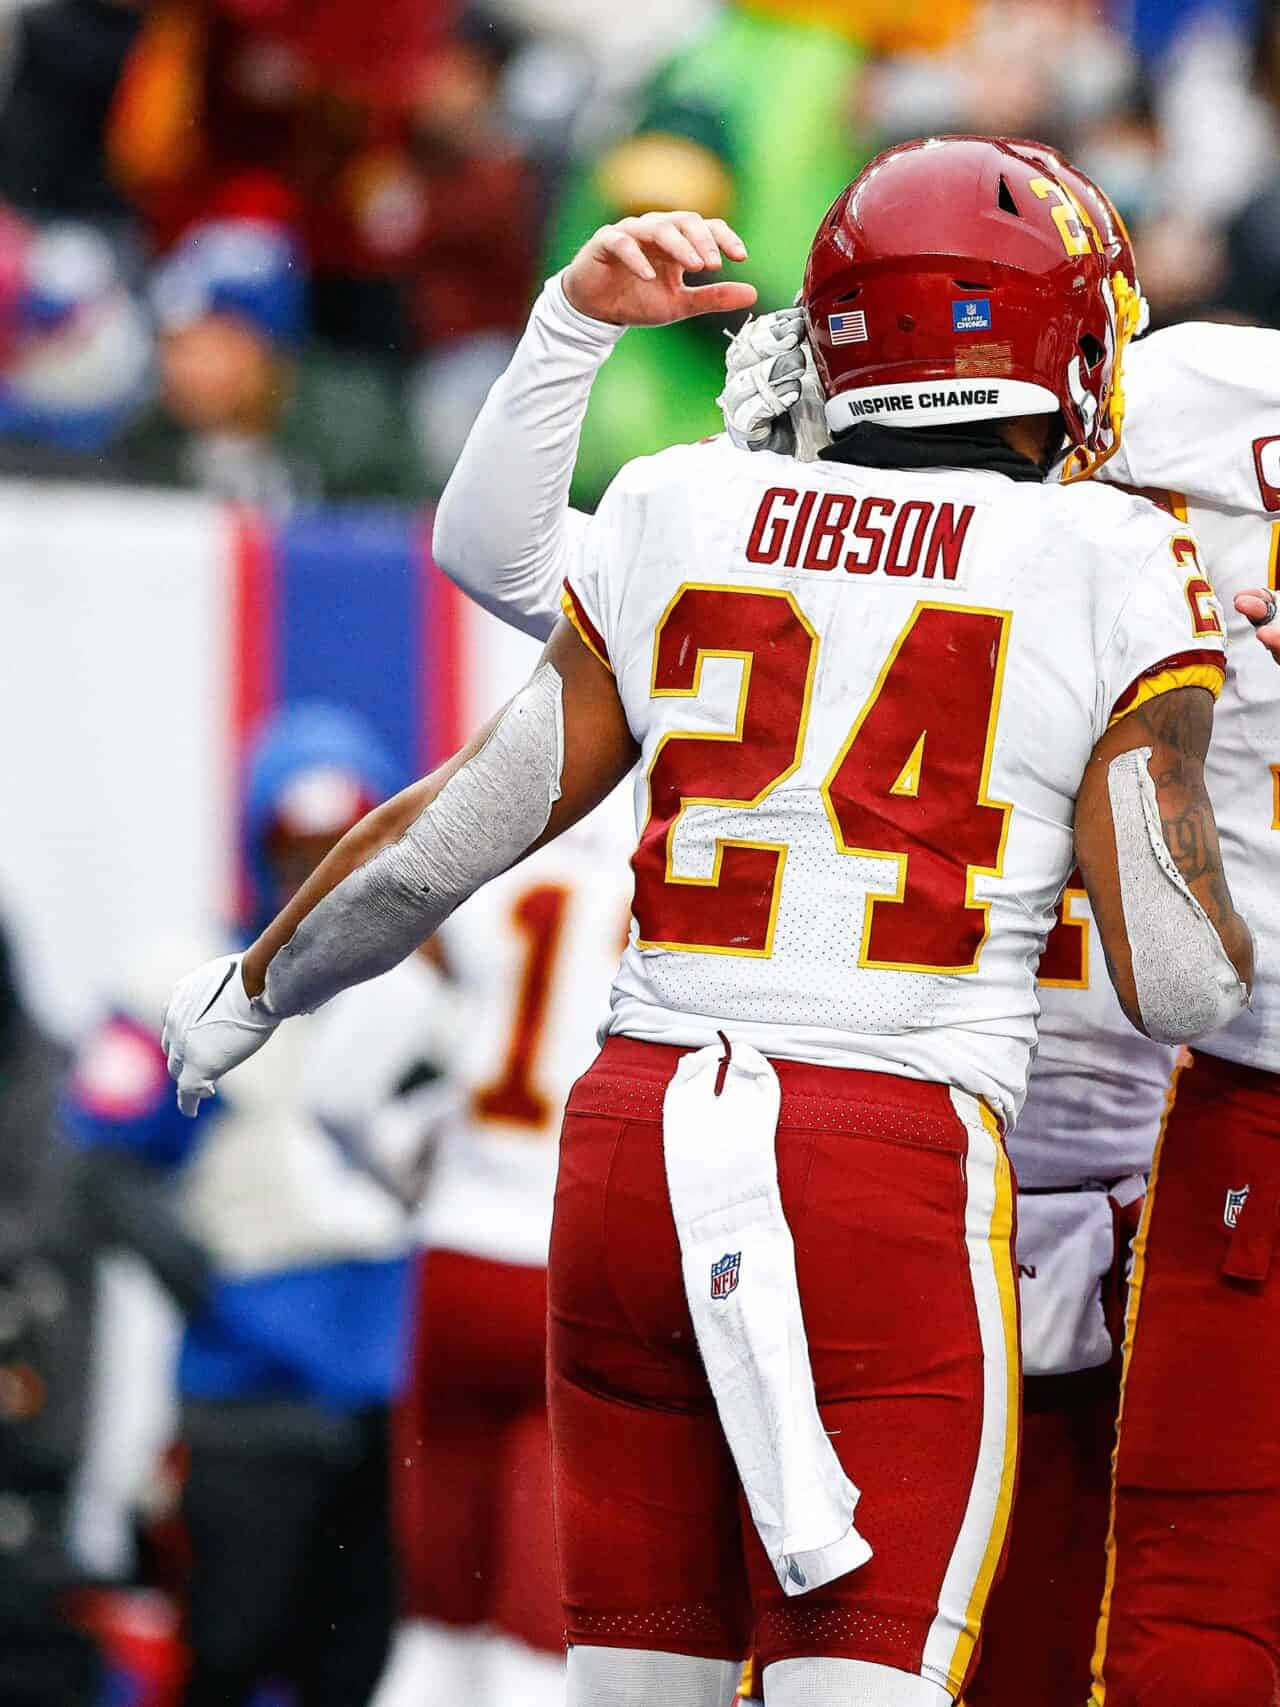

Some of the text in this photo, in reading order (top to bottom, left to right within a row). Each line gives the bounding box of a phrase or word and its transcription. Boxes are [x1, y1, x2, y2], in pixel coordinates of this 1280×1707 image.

[848, 389, 1000, 417] INSPIRE CHANGE
[744, 486, 975, 581] GIBSON
[630, 581, 1014, 974] 24
[713, 1269, 737, 1296] NFL
